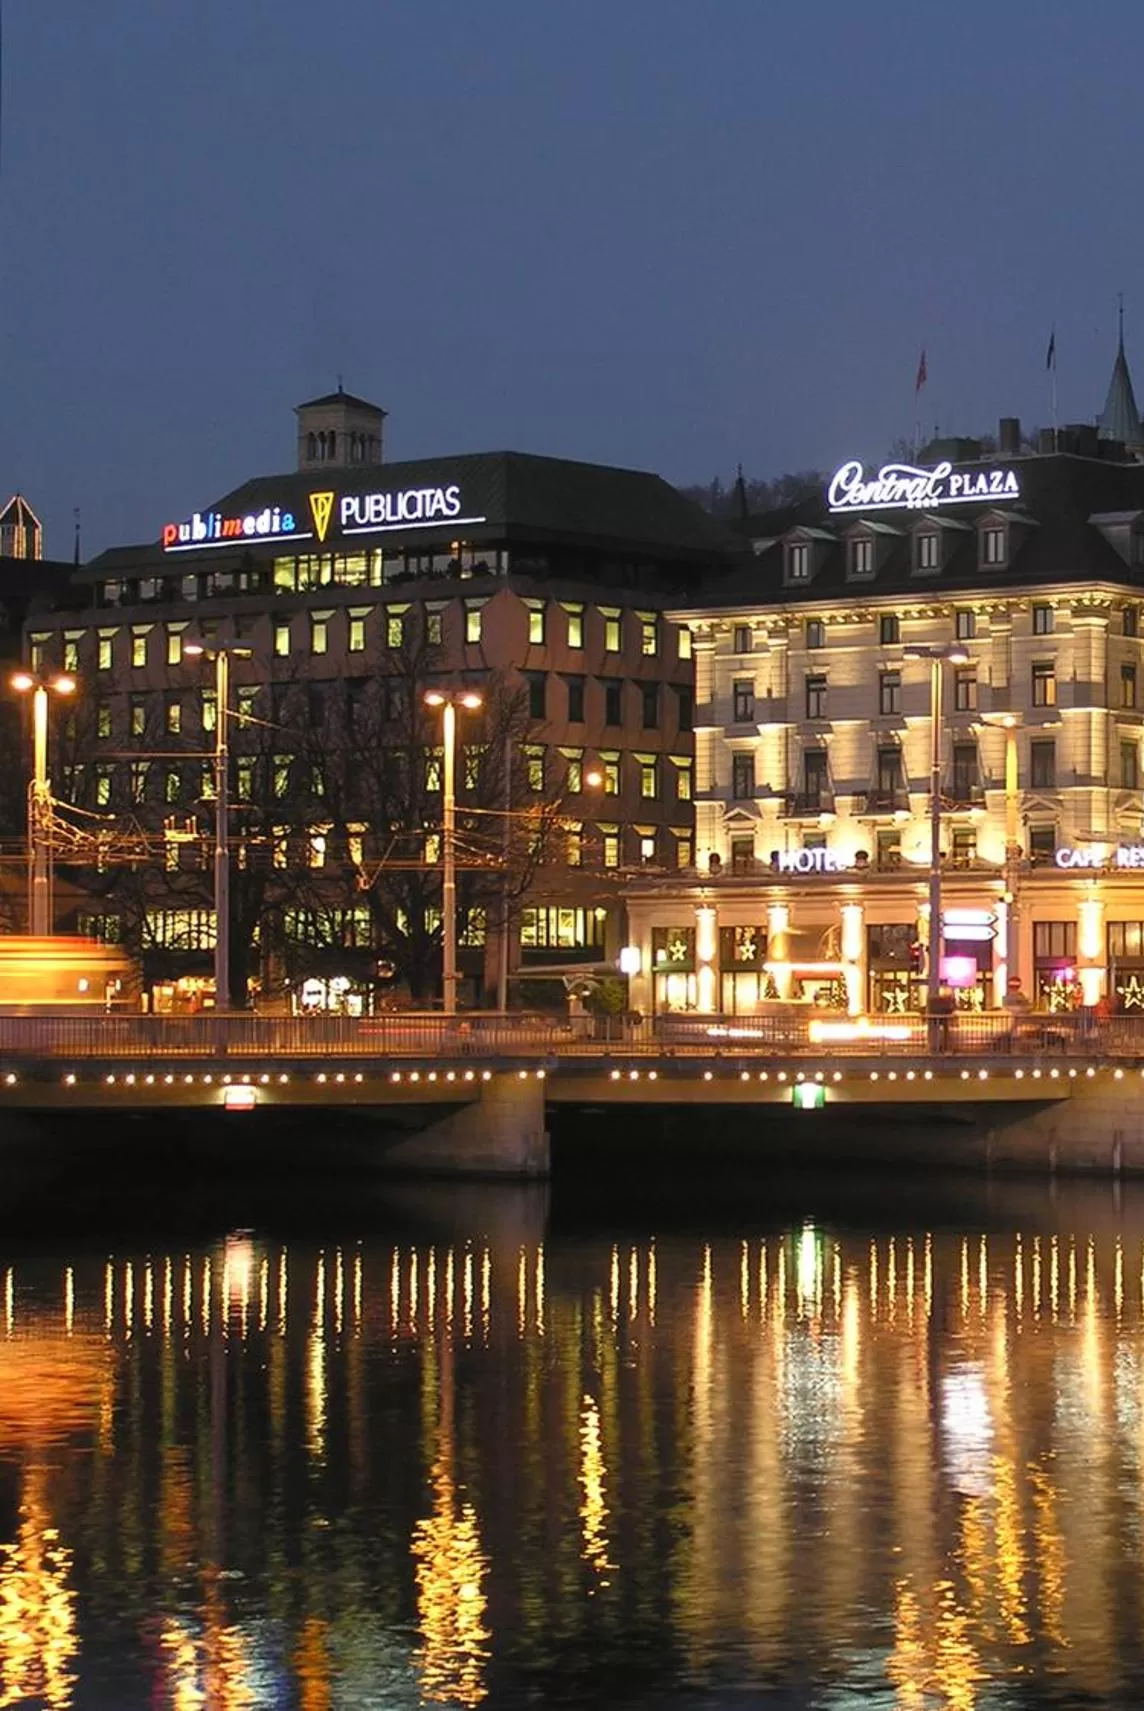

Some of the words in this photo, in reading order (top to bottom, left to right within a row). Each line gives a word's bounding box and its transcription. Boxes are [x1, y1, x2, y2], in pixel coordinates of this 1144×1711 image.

[829, 461, 952, 506] Central
[950, 470, 1019, 496] PLAZA
[341, 486, 461, 525] PUBLICITAS
[163, 508, 296, 546] publimedia
